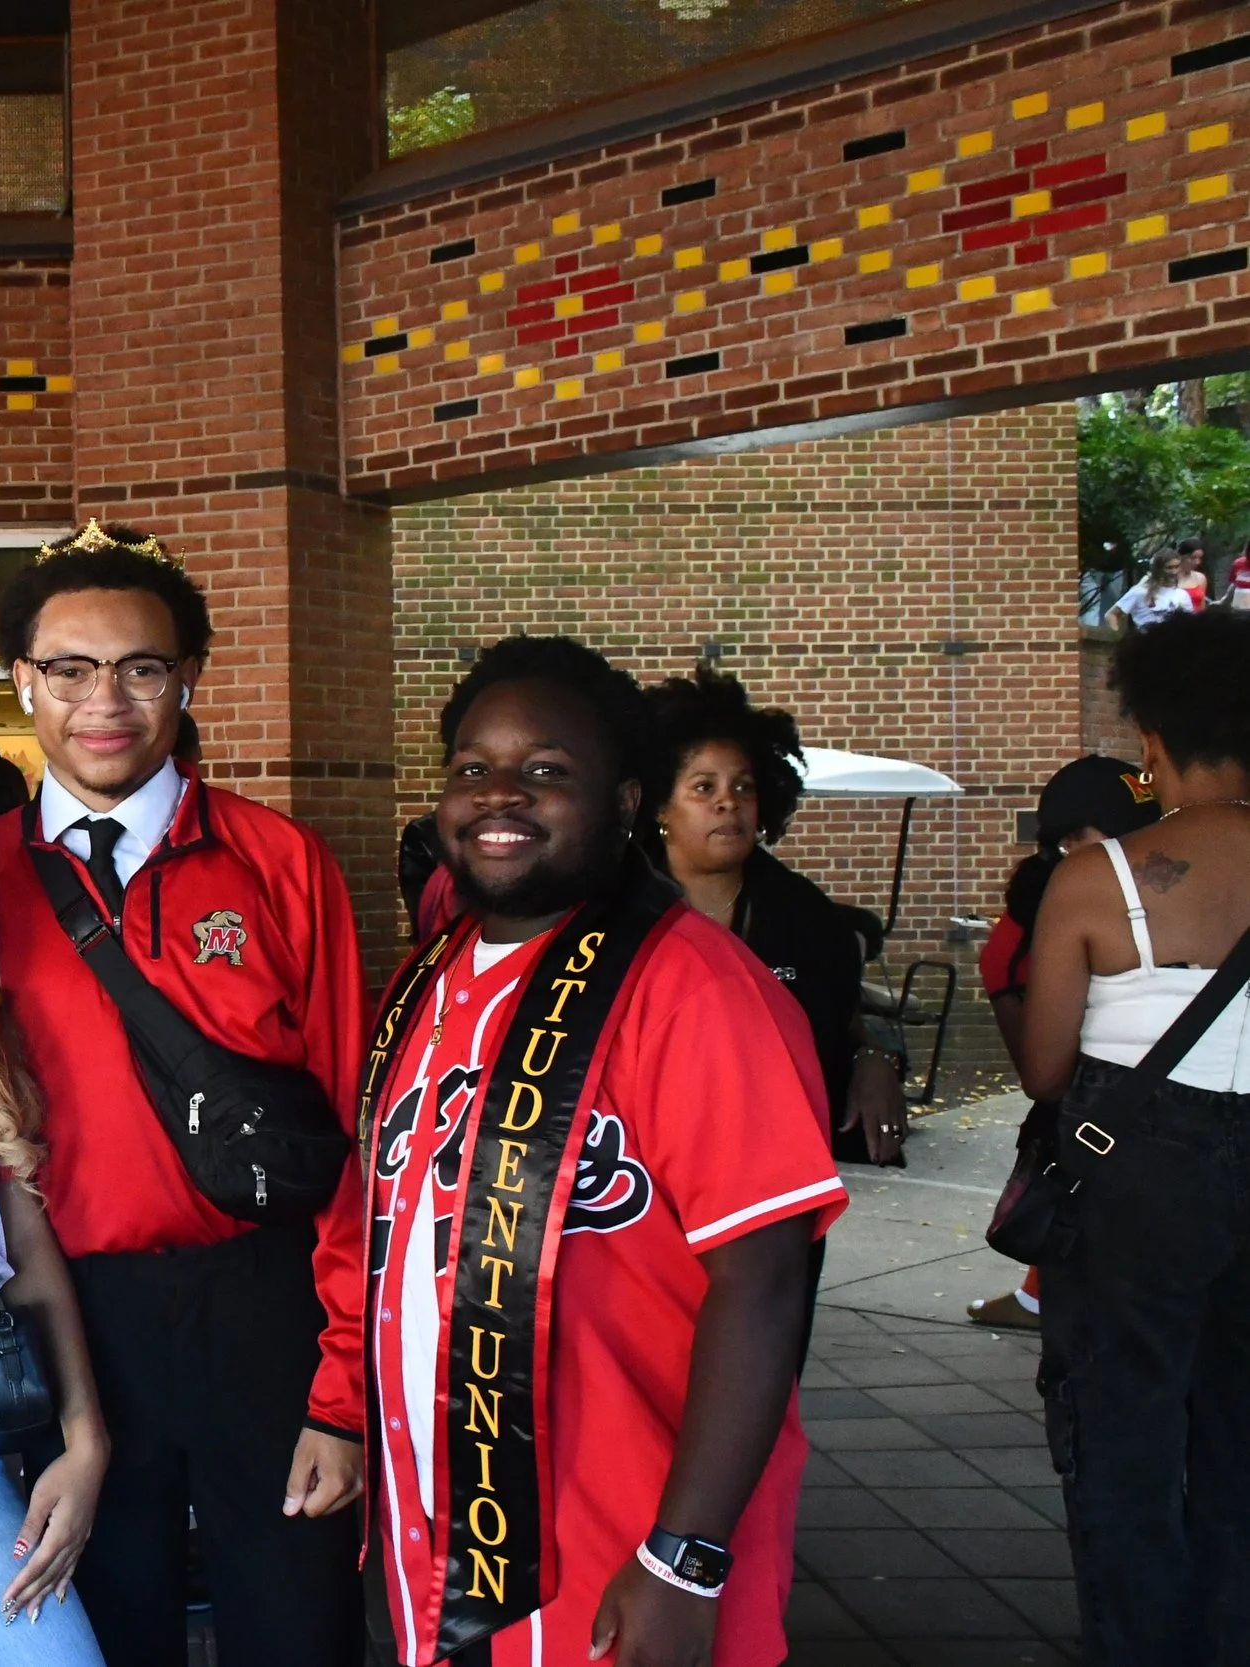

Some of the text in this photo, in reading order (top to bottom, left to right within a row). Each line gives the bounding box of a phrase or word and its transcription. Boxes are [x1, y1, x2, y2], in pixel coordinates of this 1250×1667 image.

[205, 927, 241, 952] M
[359, 934, 449, 1160] MISTE
[463, 931, 606, 1604] STUDENT UNION
